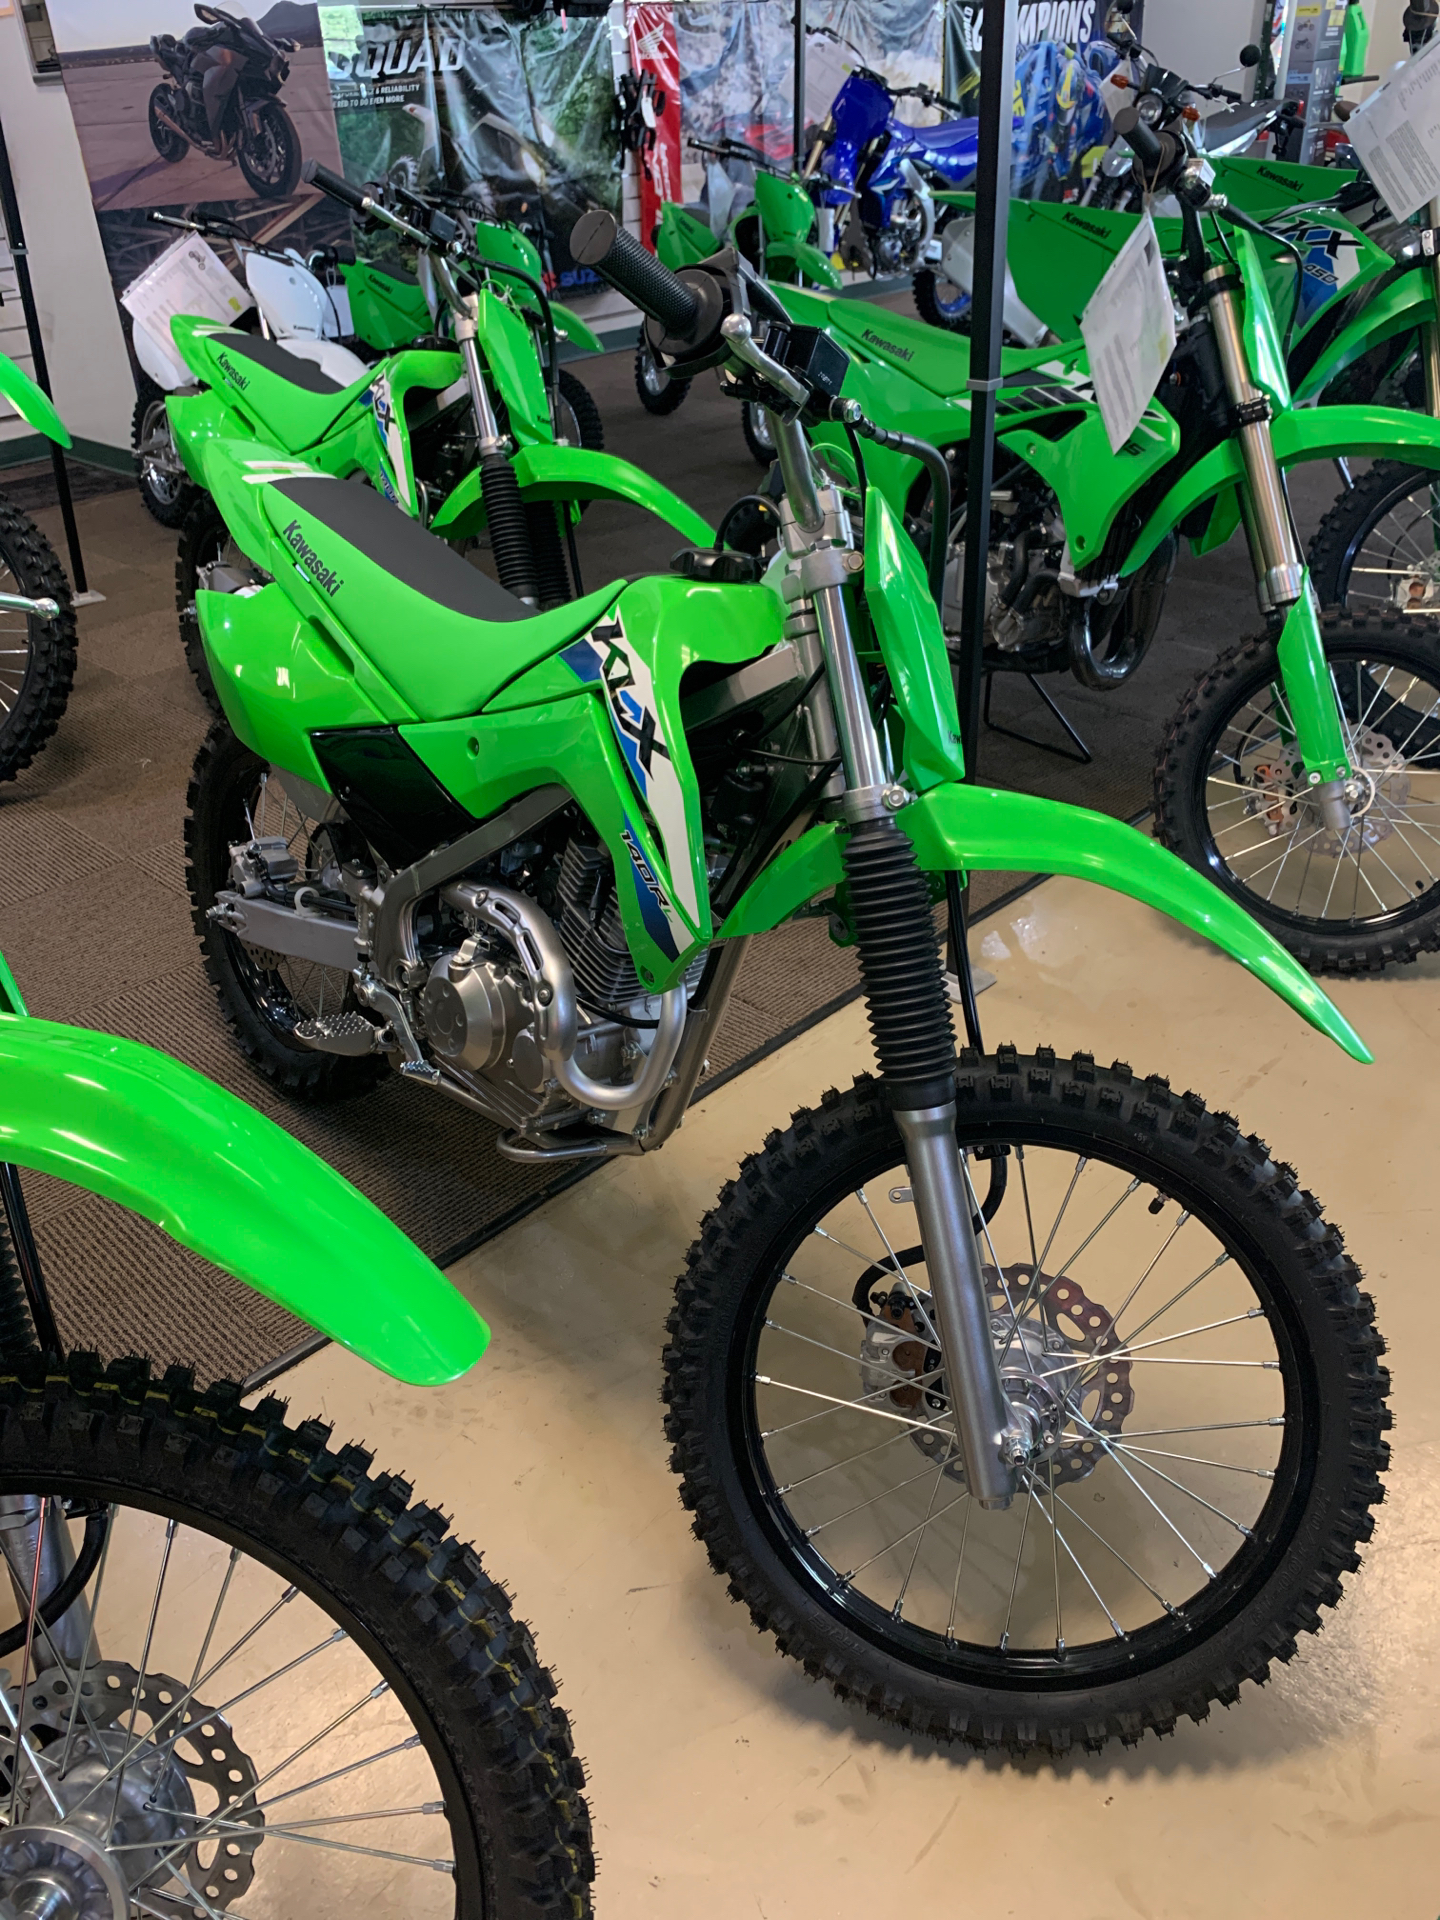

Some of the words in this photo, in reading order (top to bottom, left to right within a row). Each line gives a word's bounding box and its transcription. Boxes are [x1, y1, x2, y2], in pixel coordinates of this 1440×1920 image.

[380, 84, 420, 95] RELIABILITY
[385, 95, 405, 104] MORE
[1257, 165, 1304, 193] Kawasaki
[1062, 211, 1112, 239] Kawasaki
[861, 328, 915, 363] Kawasaki
[215, 350, 251, 392] Kawasaki
[282, 518, 346, 599] Kawasaki
